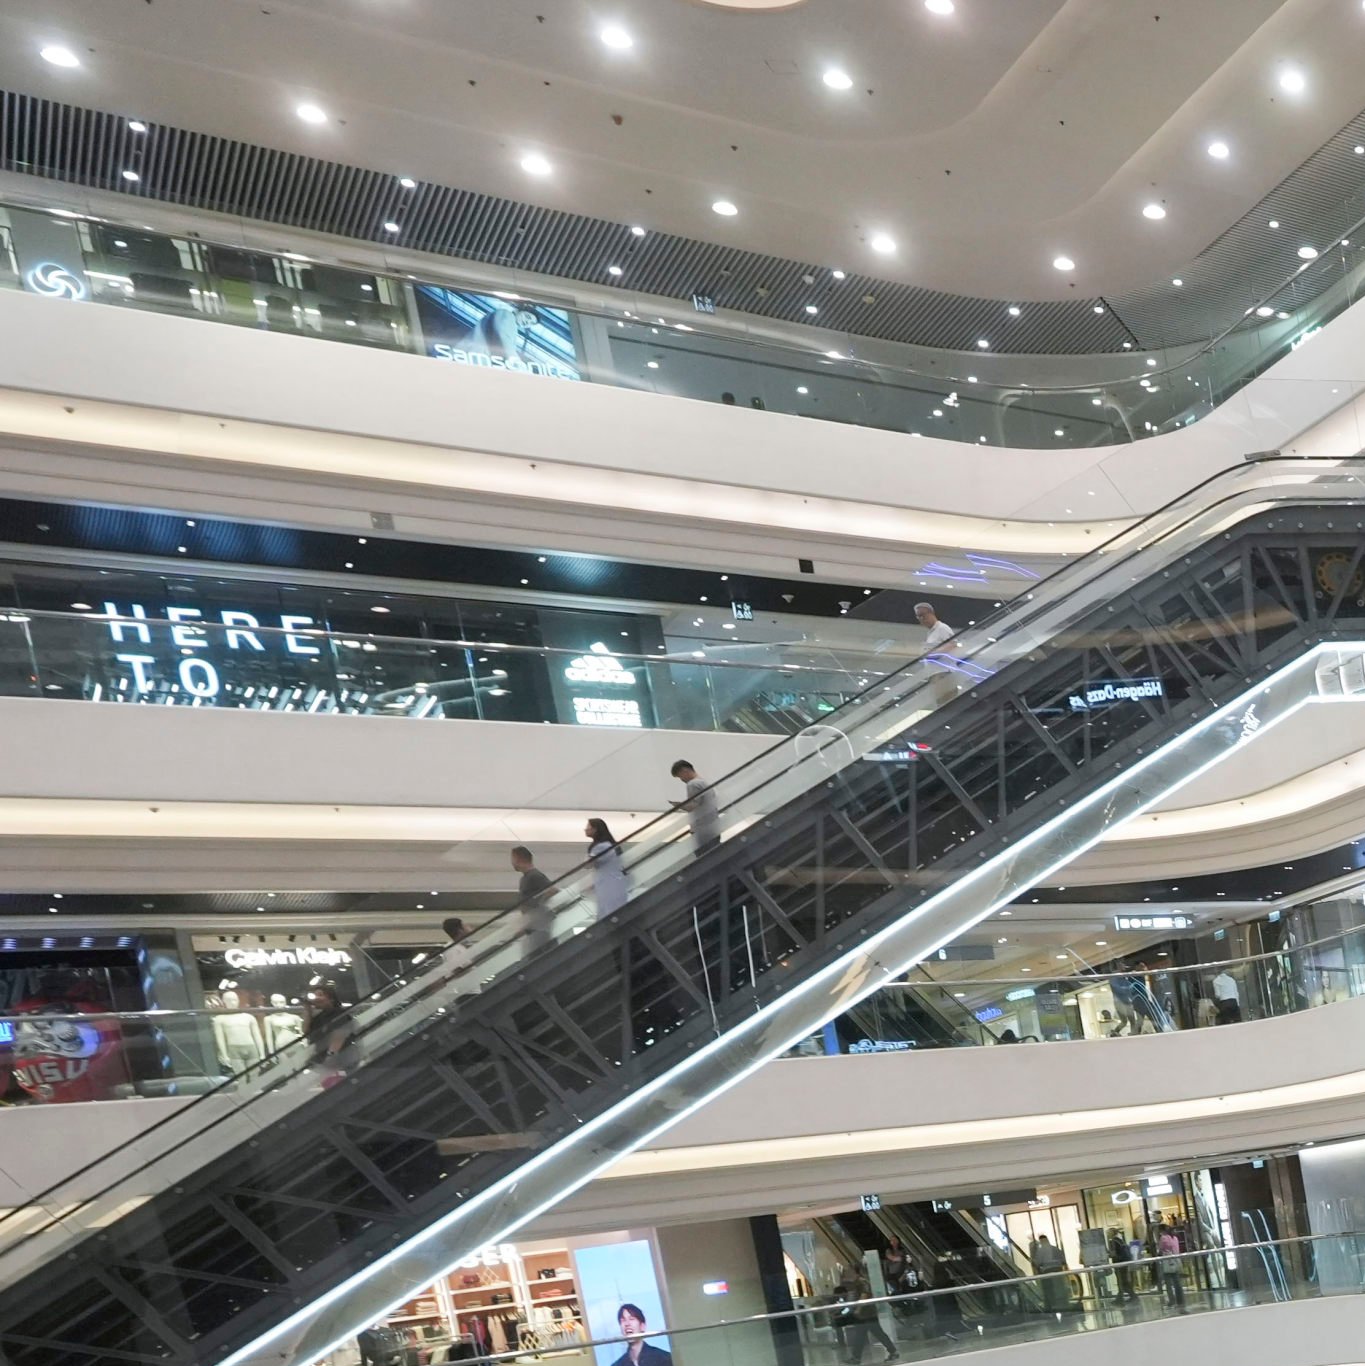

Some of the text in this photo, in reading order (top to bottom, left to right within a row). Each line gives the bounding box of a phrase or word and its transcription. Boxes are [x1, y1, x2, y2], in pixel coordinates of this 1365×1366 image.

[103, 602, 321, 655] HERE
[116, 653, 220, 698] TO
[983, 1195, 992, 1206] 5
